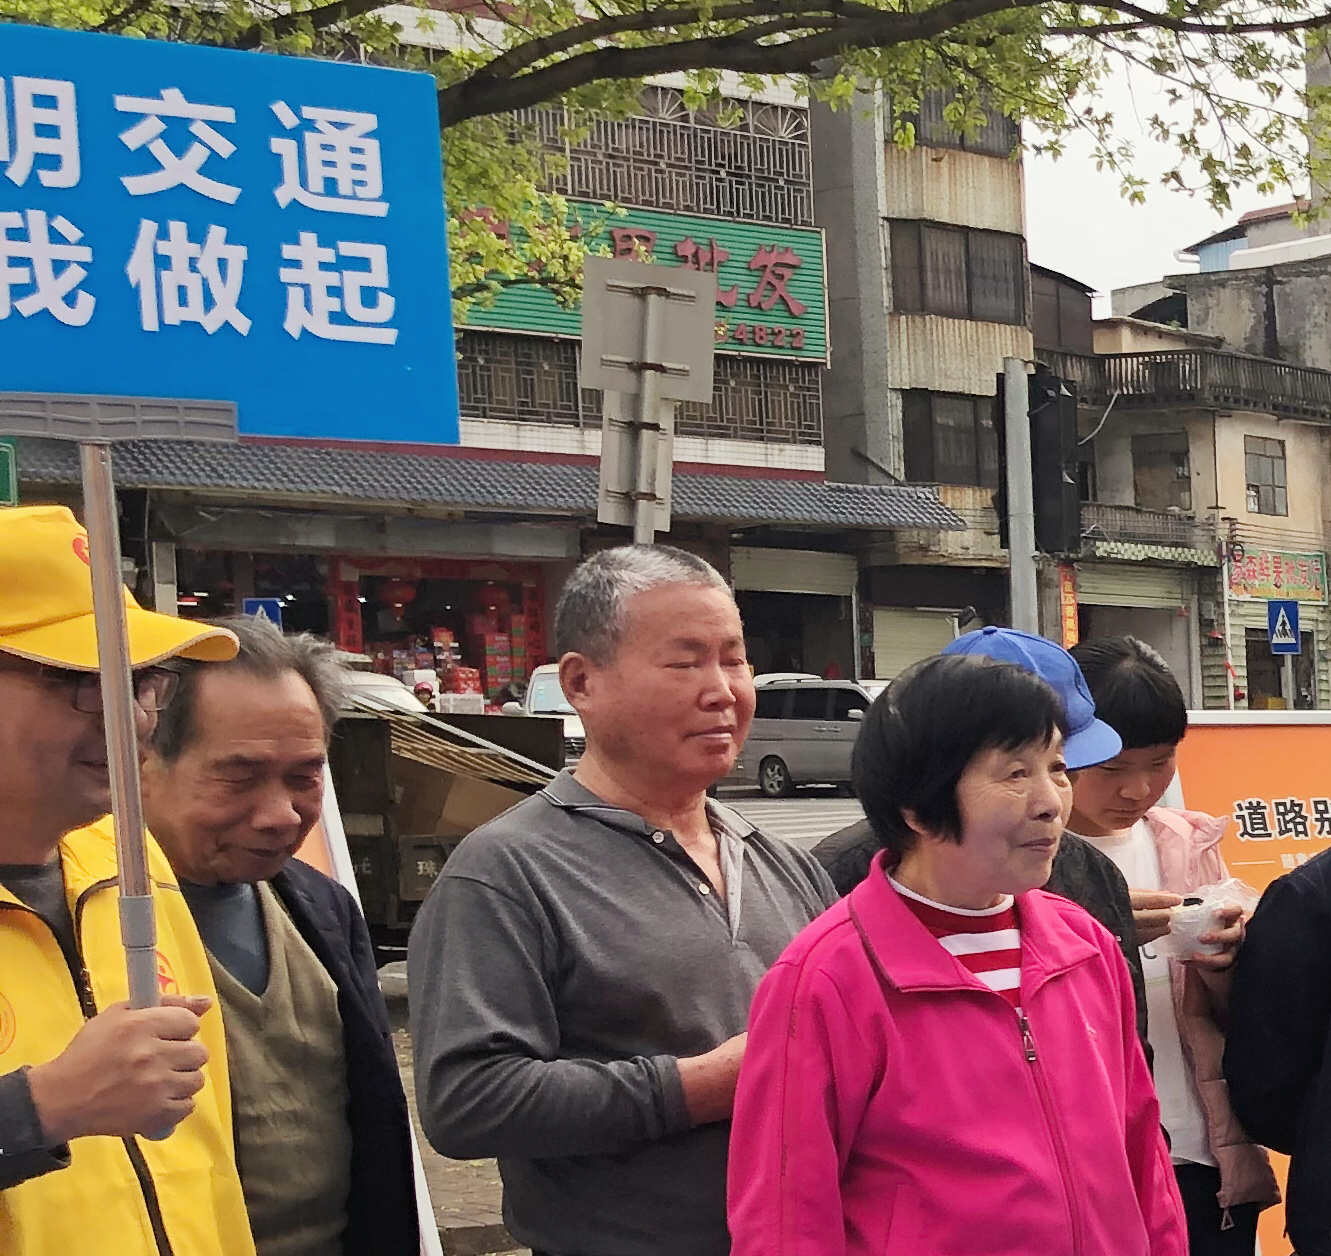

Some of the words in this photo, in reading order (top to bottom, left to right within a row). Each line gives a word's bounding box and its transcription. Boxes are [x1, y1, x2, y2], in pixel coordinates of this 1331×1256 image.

[0, 76, 389, 217] 明交通
[0, 209, 399, 345] 我做起
